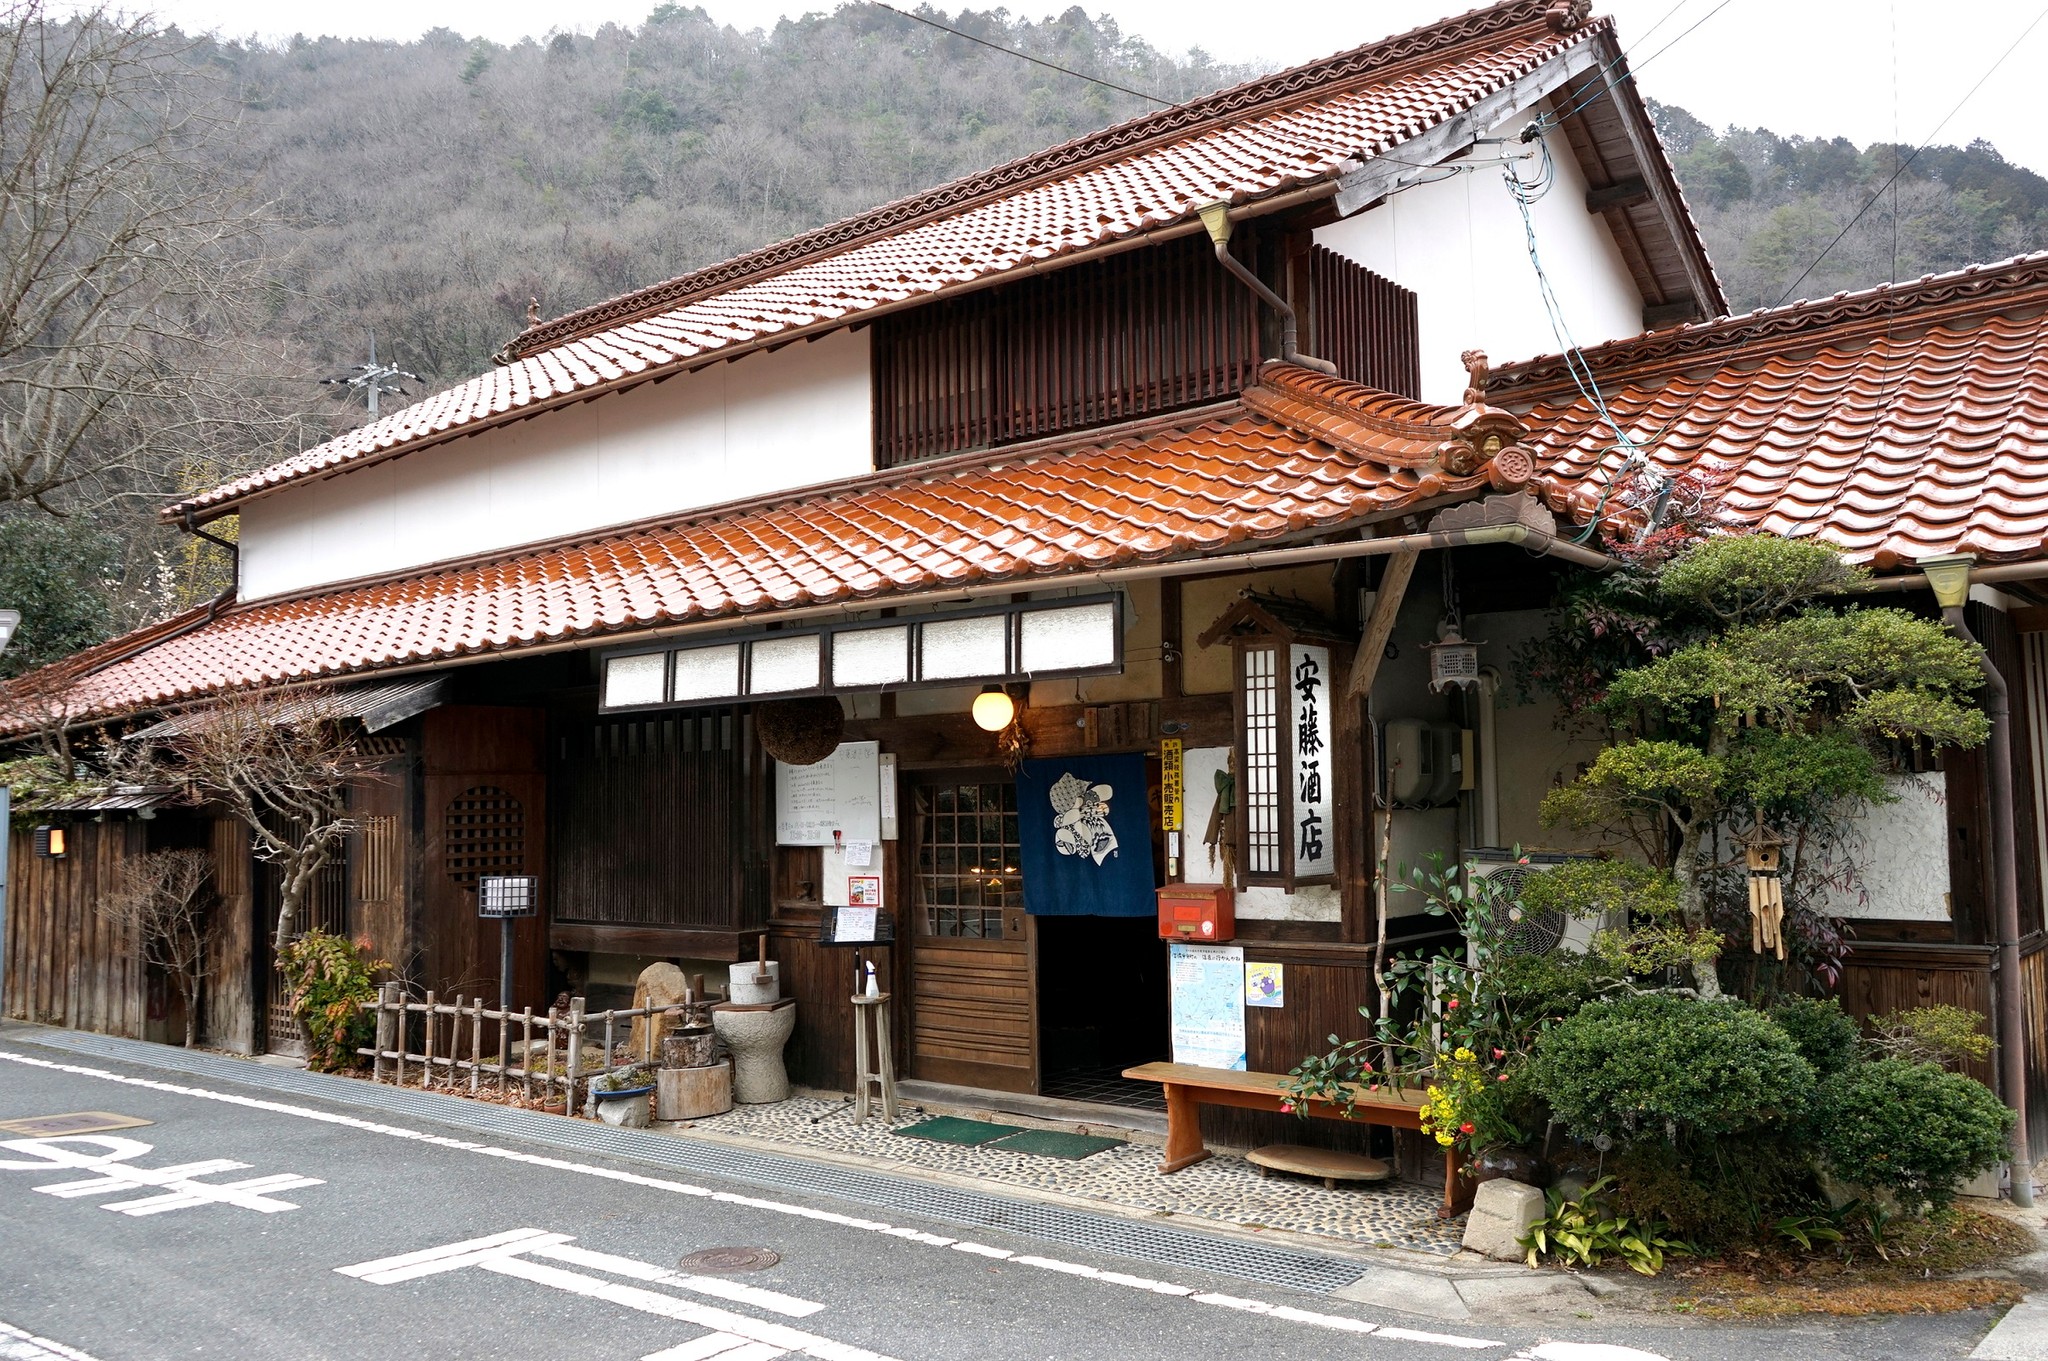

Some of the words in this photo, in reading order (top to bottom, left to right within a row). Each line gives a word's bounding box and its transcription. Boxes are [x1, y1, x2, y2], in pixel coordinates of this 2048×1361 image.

[1163, 749, 1174, 827] 酒類小売販売店
[1294, 653, 1324, 863] 安藤酒店
